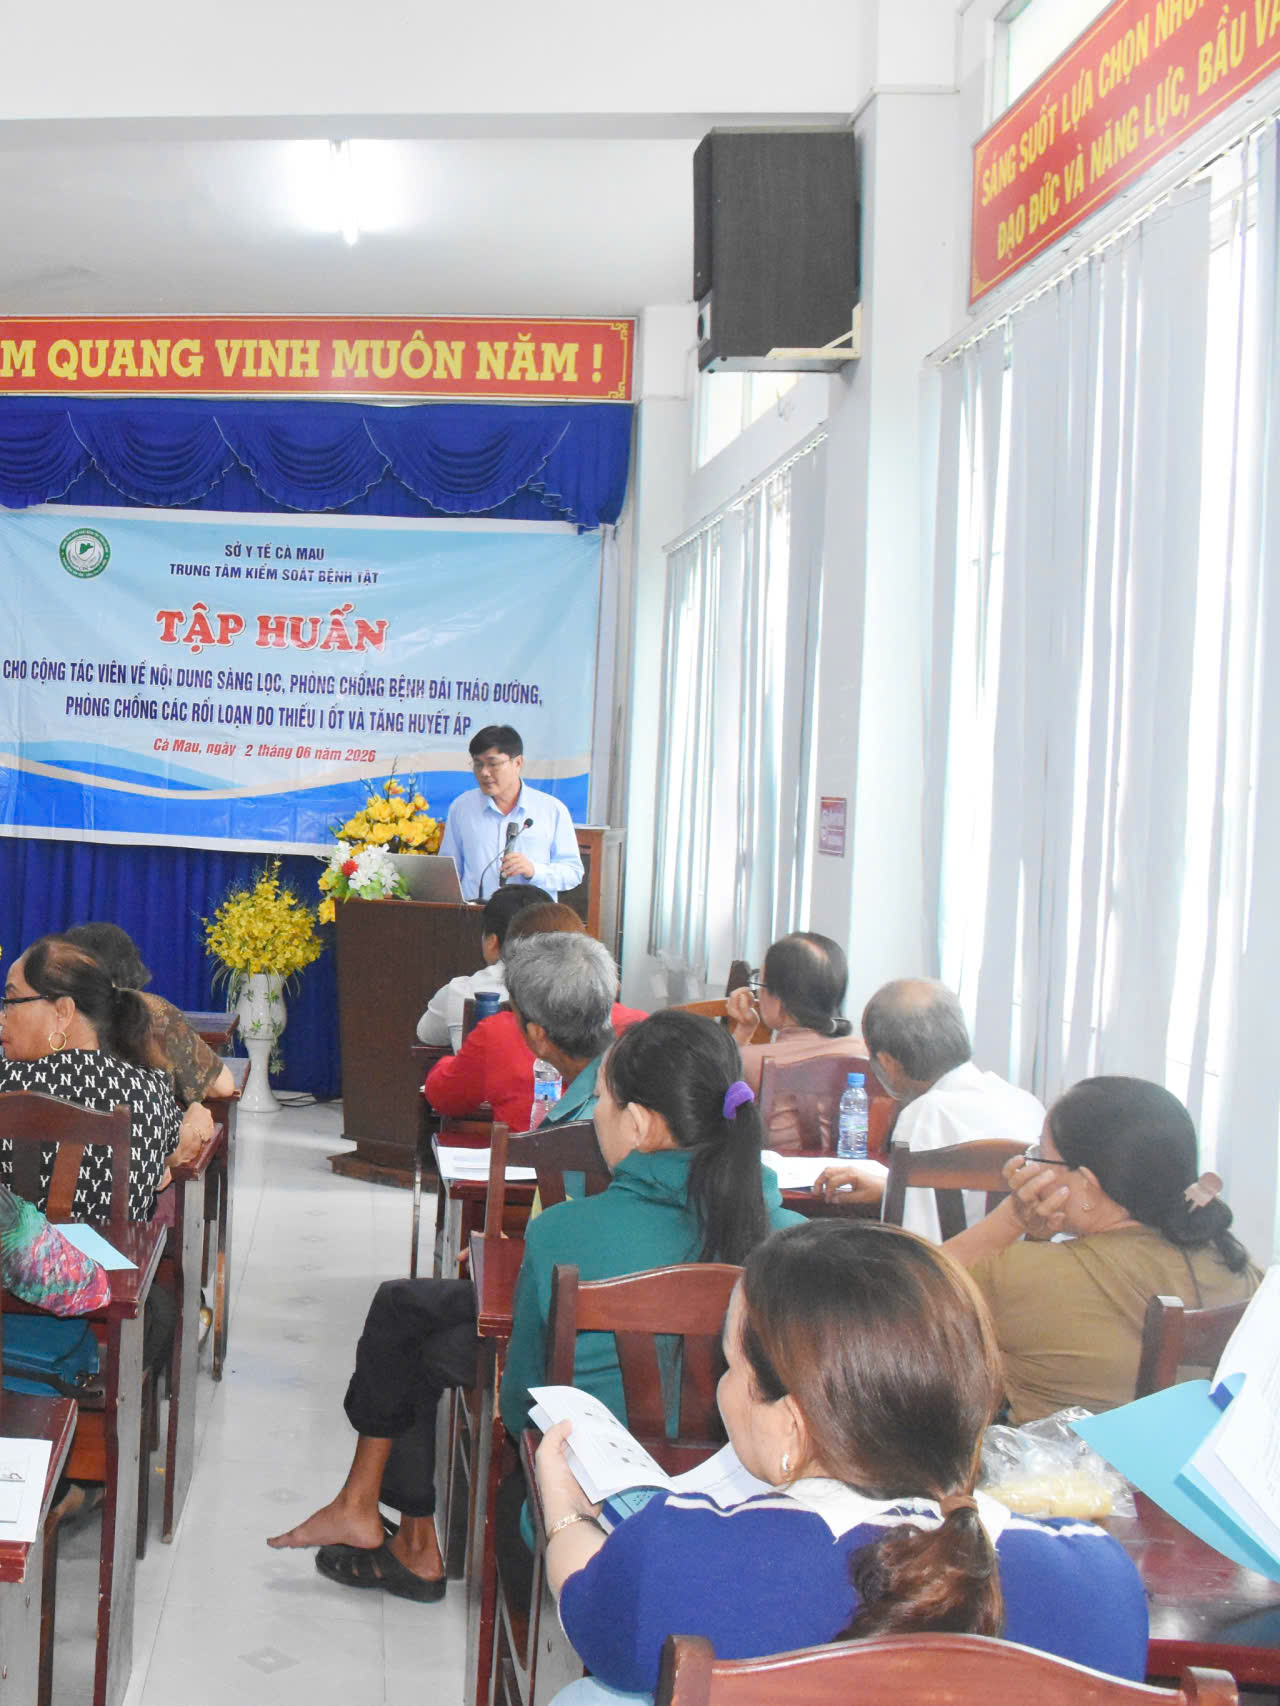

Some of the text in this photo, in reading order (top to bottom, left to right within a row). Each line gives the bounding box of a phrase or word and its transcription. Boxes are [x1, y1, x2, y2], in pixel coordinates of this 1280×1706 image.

[982, 144, 1016, 206] SÁNG
[1020, 93, 1057, 172] SUỐT
[1062, 68, 1093, 134] LỰA
[1098, 13, 1150, 98] CHỌN
[997, 204, 1025, 260] ĐẠO
[1029, 171, 1060, 234] ĐỨC
[1064, 143, 1084, 205] VÀ
[1090, 105, 1138, 184] NĂNG
[1143, 65, 1190, 139] LỰC,
[1197, 3, 1247, 96] BẦU
[47, 339, 203, 379] QUANG
[214, 339, 320, 377] VINH
[331, 330, 465, 379] MUÔN
[475, 333, 579, 381] NĂM
[170, 562, 378, 586] TRUNG TÂM KIỂM SOÁT BỆNH TẬT
[225, 541, 324, 560] SỞ Y TẾ CÀ MAU
[156, 601, 389, 653] TẬP HUẤN
[3, 657, 542, 706] CHO CỘNG TÁC VIÊN VỀ NỘI DUNG SÀNG LỌC, PHÒNG CHỐNG BỆNH ĐÁI THÁO ĐƯỜNG,
[66, 692, 471, 735] PHÒNG CHỐNG CÁC RỐI LOẠN DO THIẾU I ỐT VÀ TĂNG HUYẾT ÁP
[153, 738, 376, 762] Cà Mau, ngày 2 tháng 06 năm 2026
